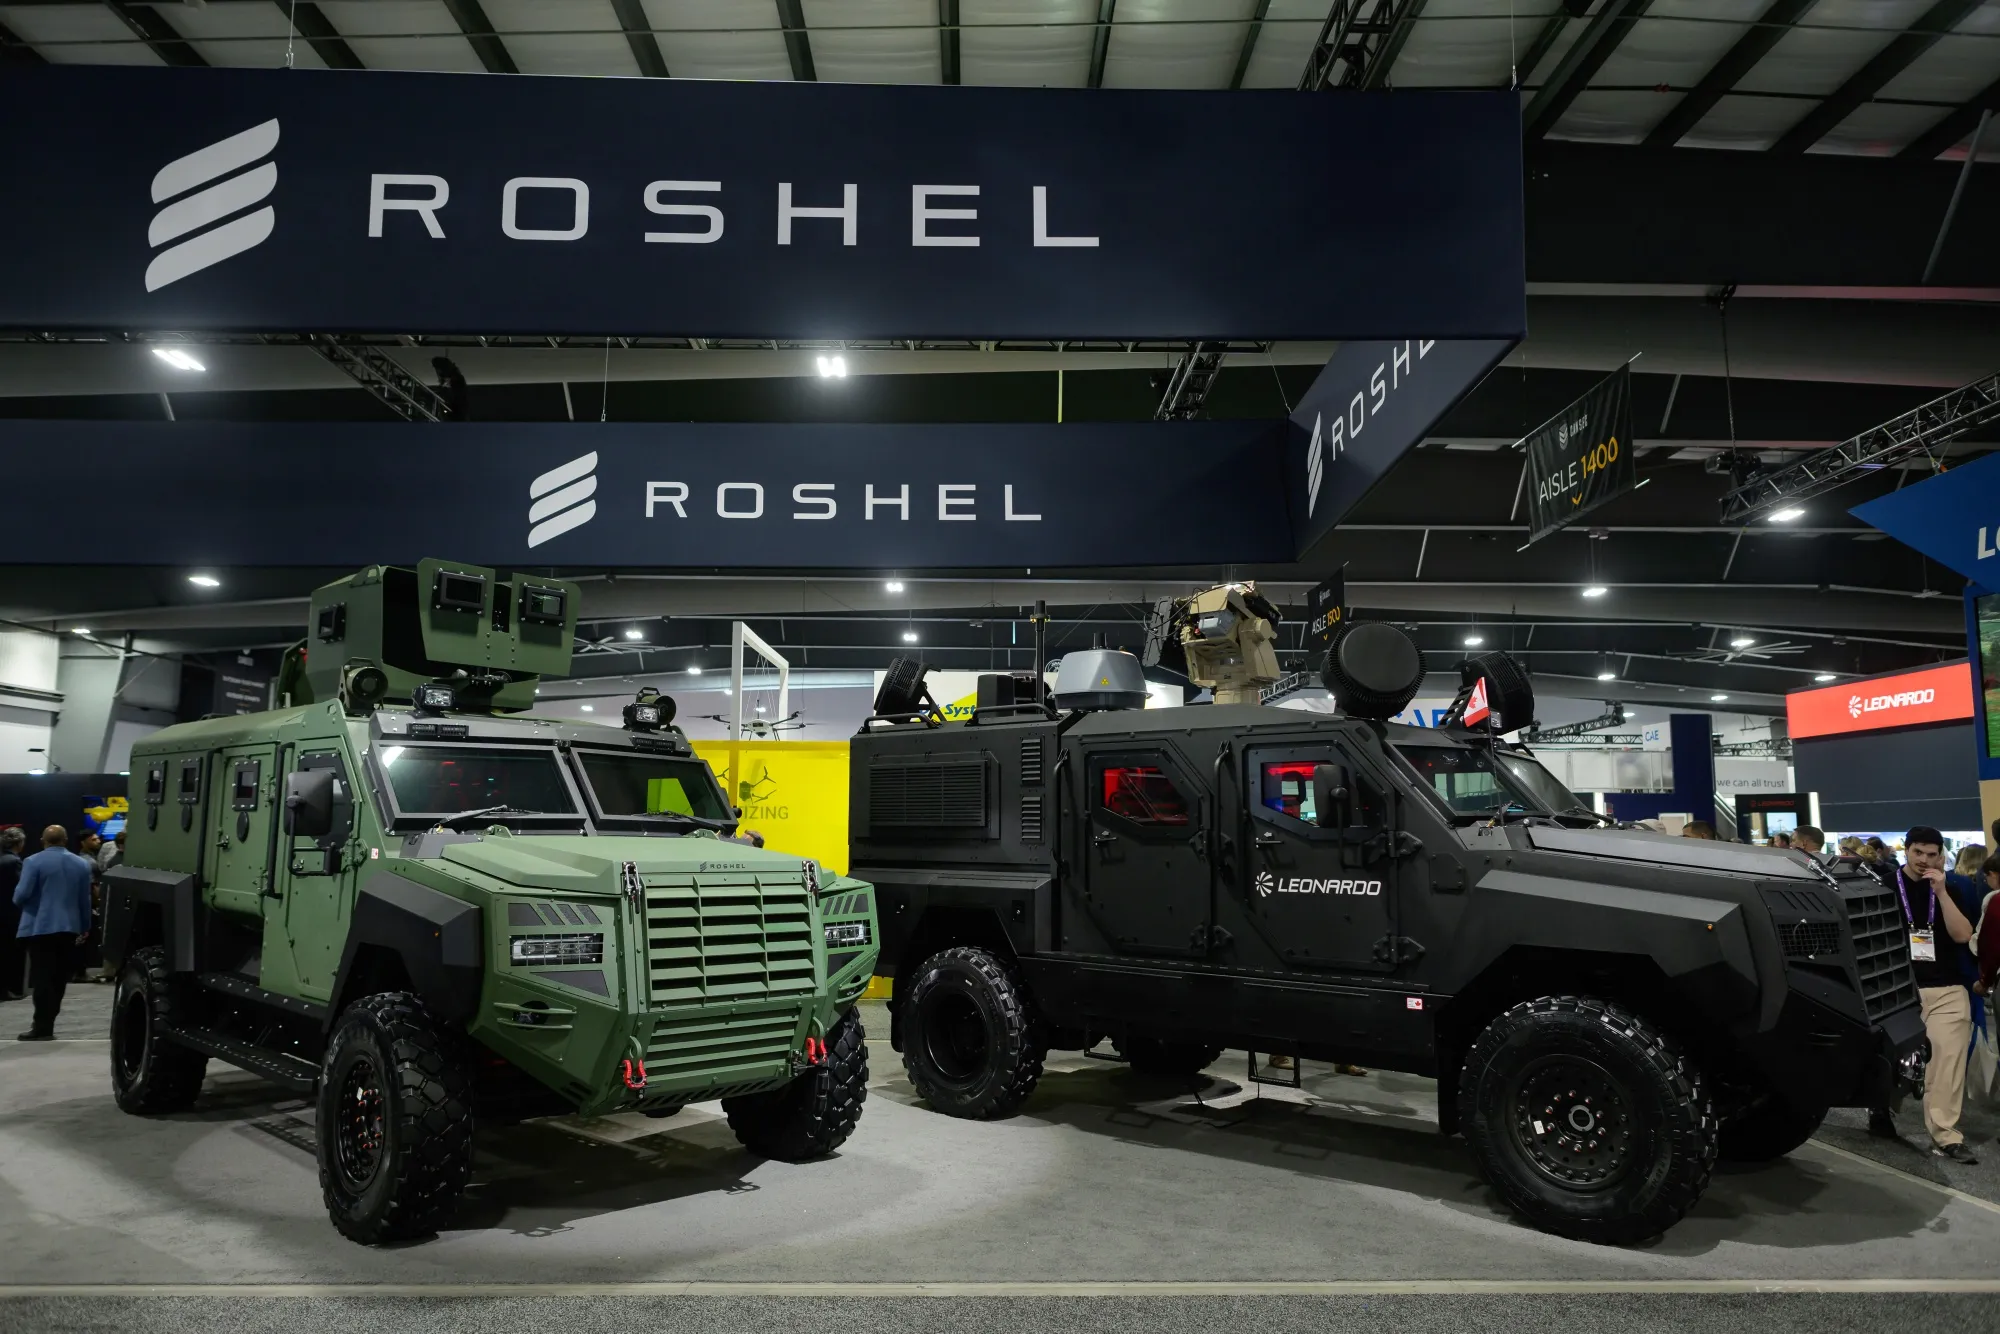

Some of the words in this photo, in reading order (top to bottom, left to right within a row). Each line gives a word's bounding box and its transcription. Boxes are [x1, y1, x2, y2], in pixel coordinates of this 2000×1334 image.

[368, 173, 1100, 247] ROSHEL
[1539, 461, 1578, 505] AISLE
[1580, 436, 1619, 479] 1400
[645, 481, 1042, 521] ROSHEL
[1311, 613, 1327, 636] AISLE
[944, 703, 977, 718] Syst
[1863, 688, 1935, 712] LEONARDO
[1751, 779, 1762, 787] all
[1763, 779, 1784, 787] trust
[740, 805, 789, 820] IZING
[1277, 877, 1383, 896] LEONARDO
